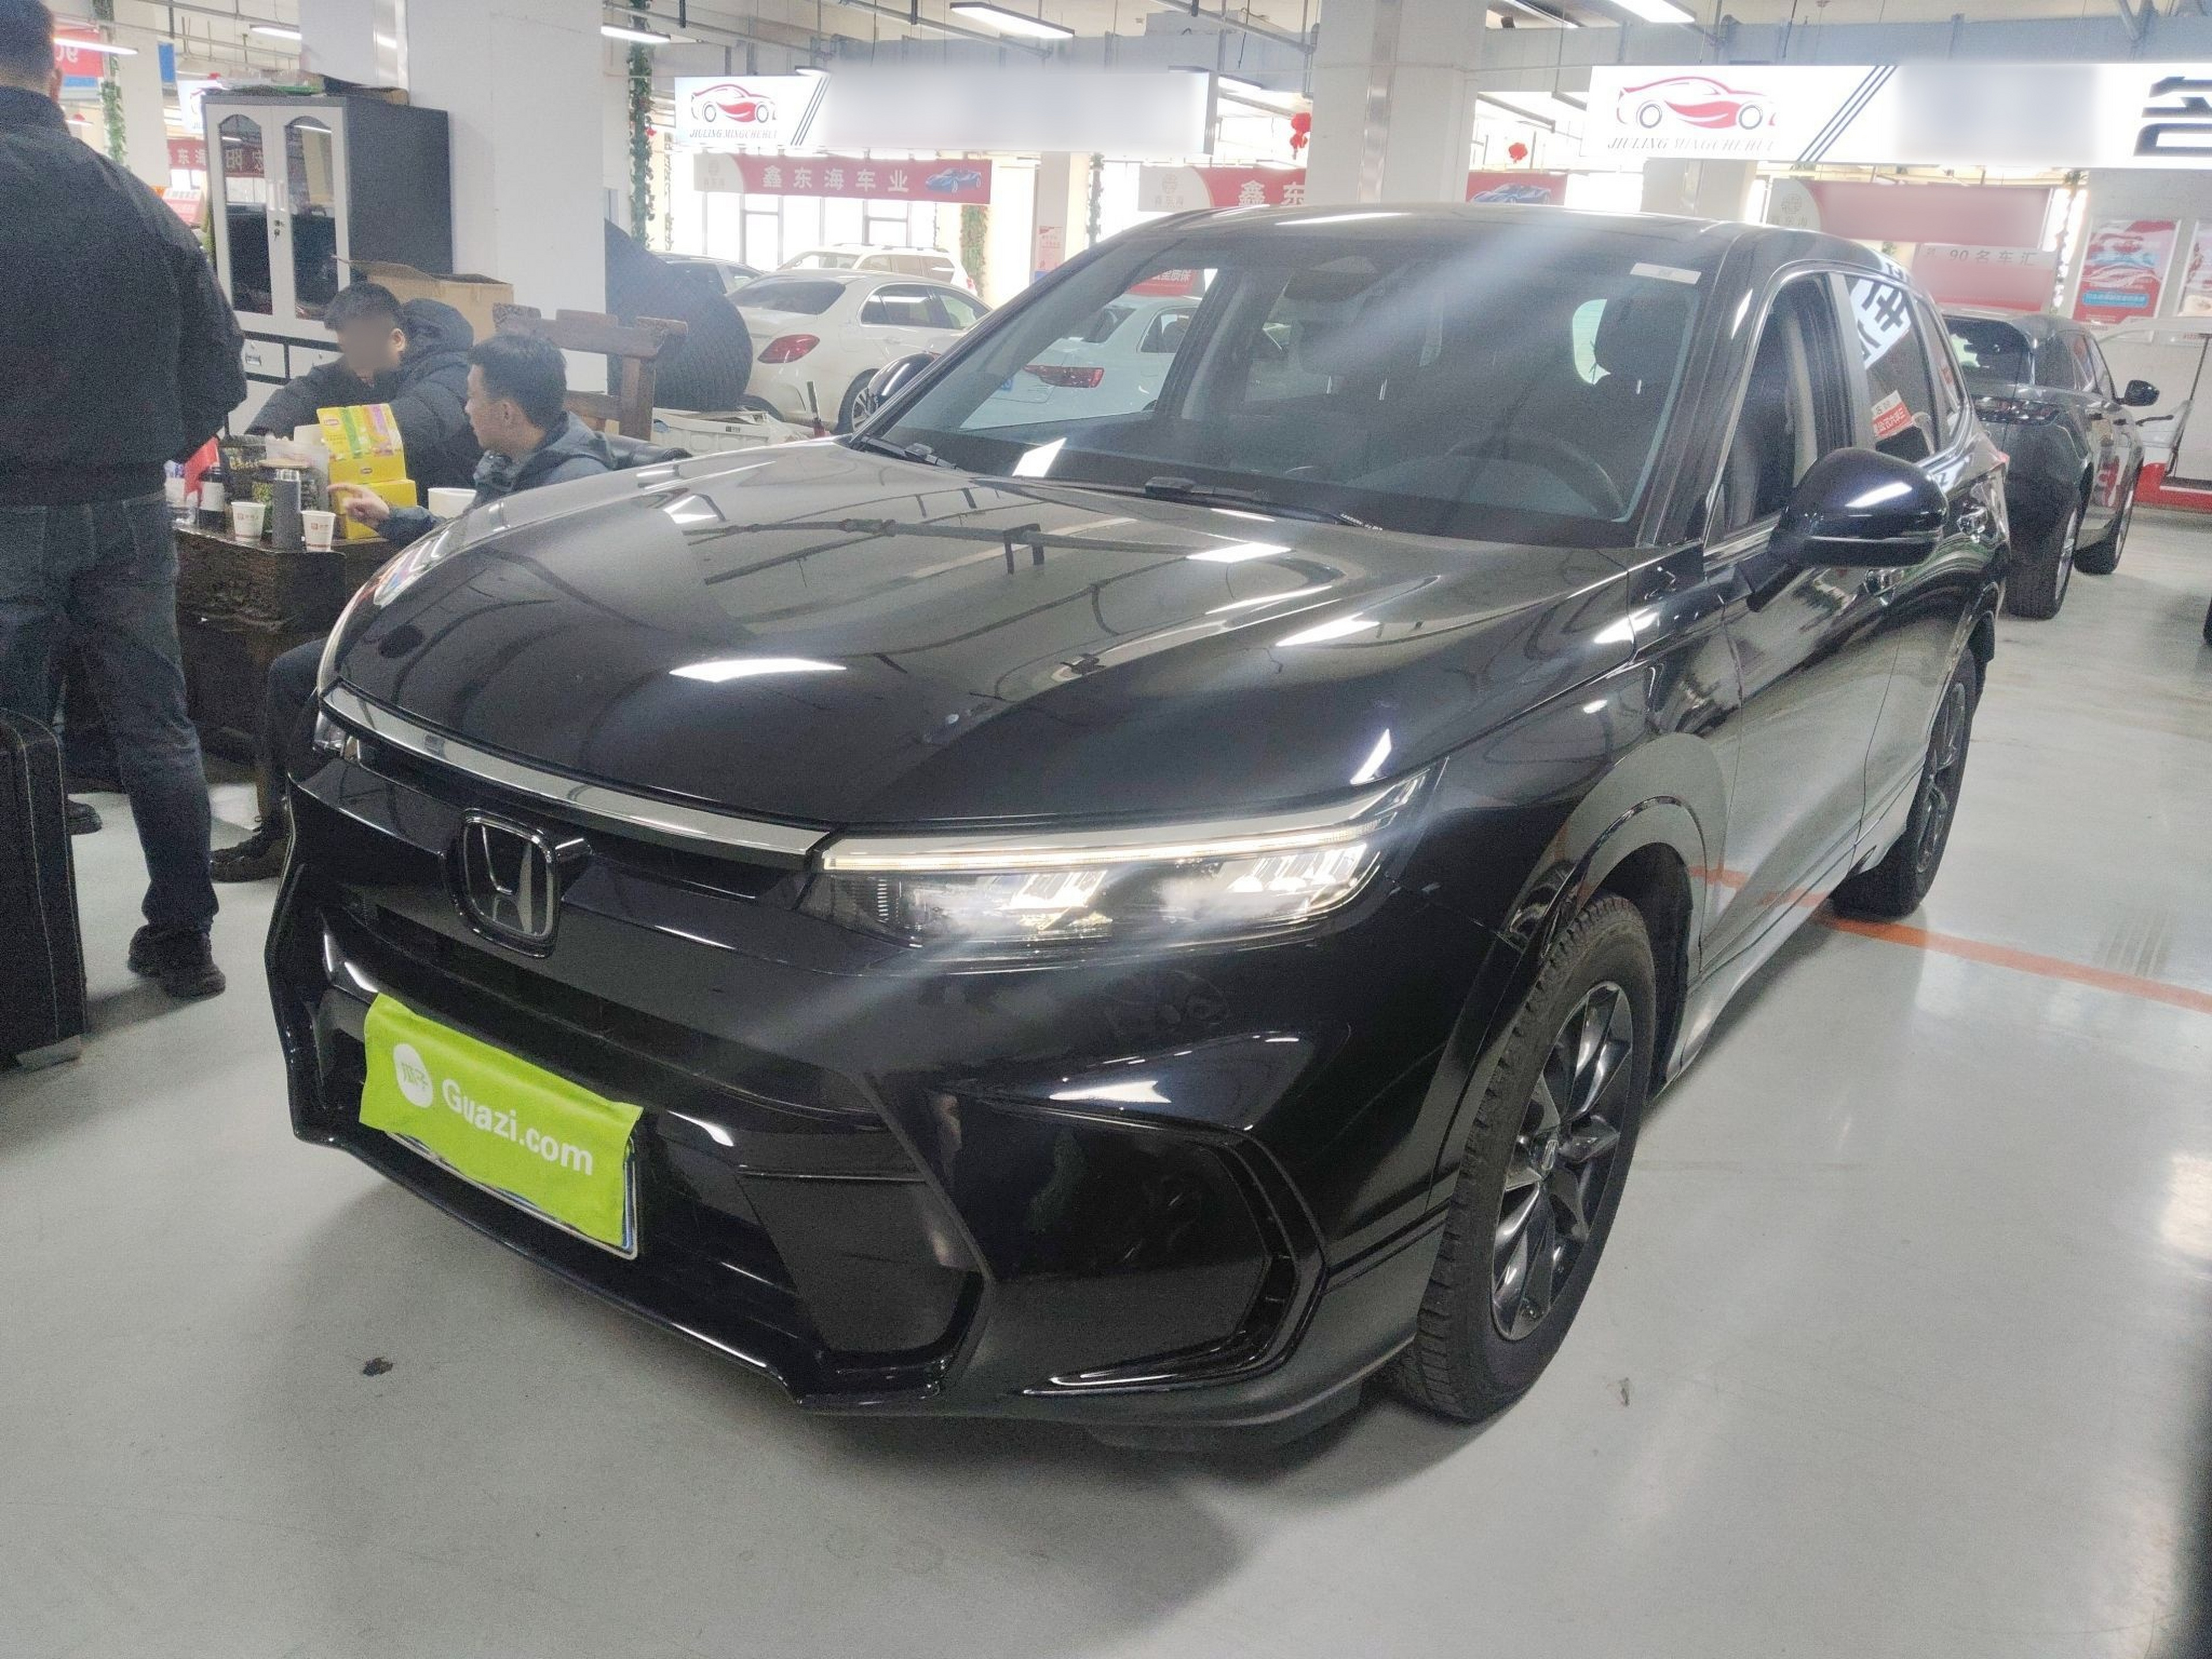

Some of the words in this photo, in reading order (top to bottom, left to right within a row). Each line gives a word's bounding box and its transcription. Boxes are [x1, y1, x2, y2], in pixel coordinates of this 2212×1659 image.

[763, 165, 909, 192] 鑫东海车业
[442, 1078, 593, 1176] Guazi.com
